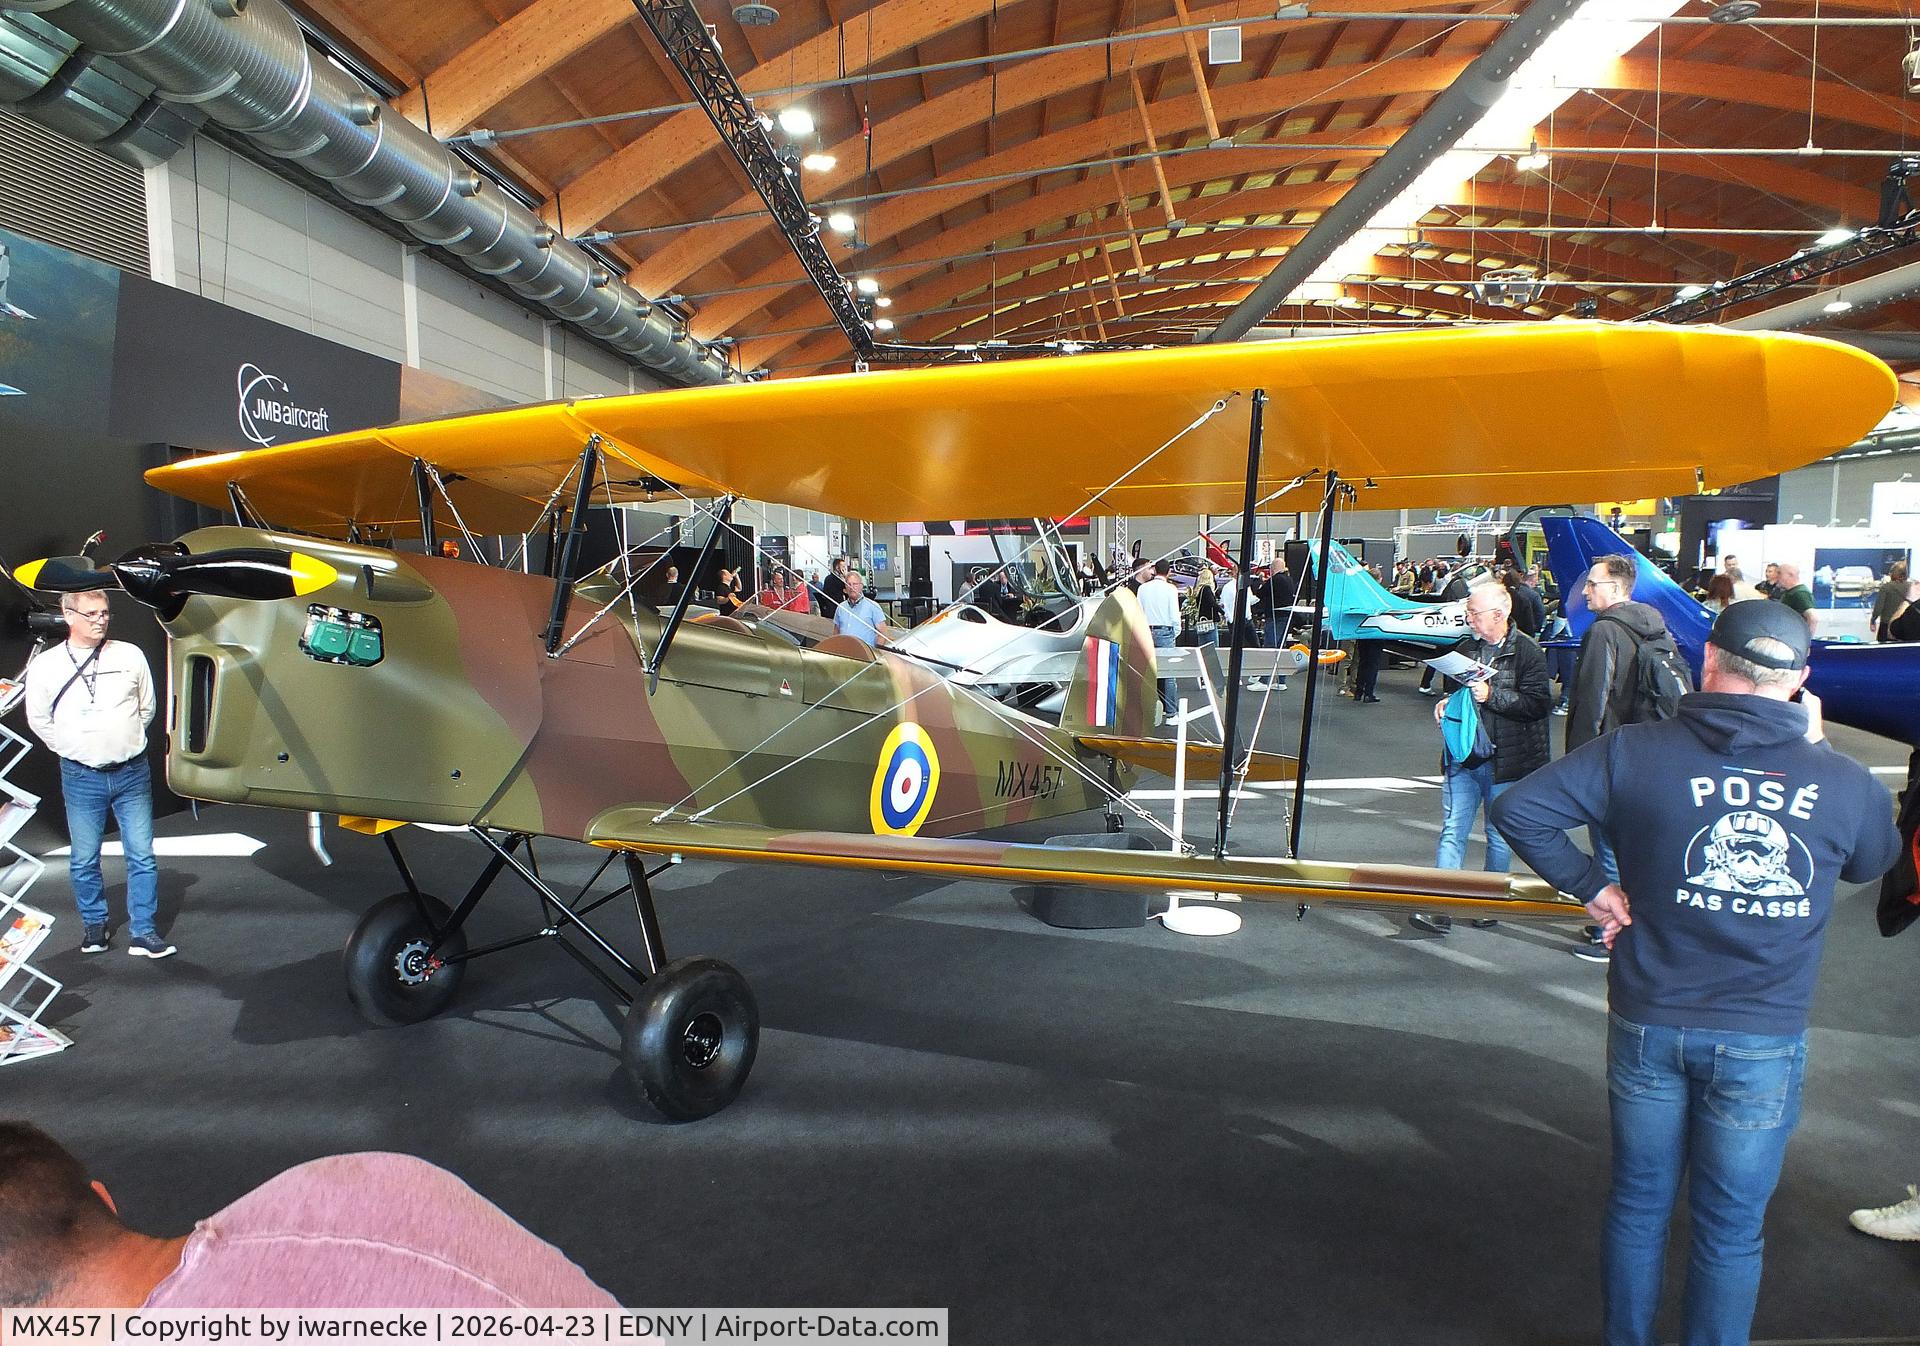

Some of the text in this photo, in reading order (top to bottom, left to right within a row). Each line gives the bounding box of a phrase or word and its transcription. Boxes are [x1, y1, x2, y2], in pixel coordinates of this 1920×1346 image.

[994, 760, 1063, 799] MX457
[1690, 776, 1819, 820] POSÉ
[1676, 888, 1811, 918] PAS CASSÉ
